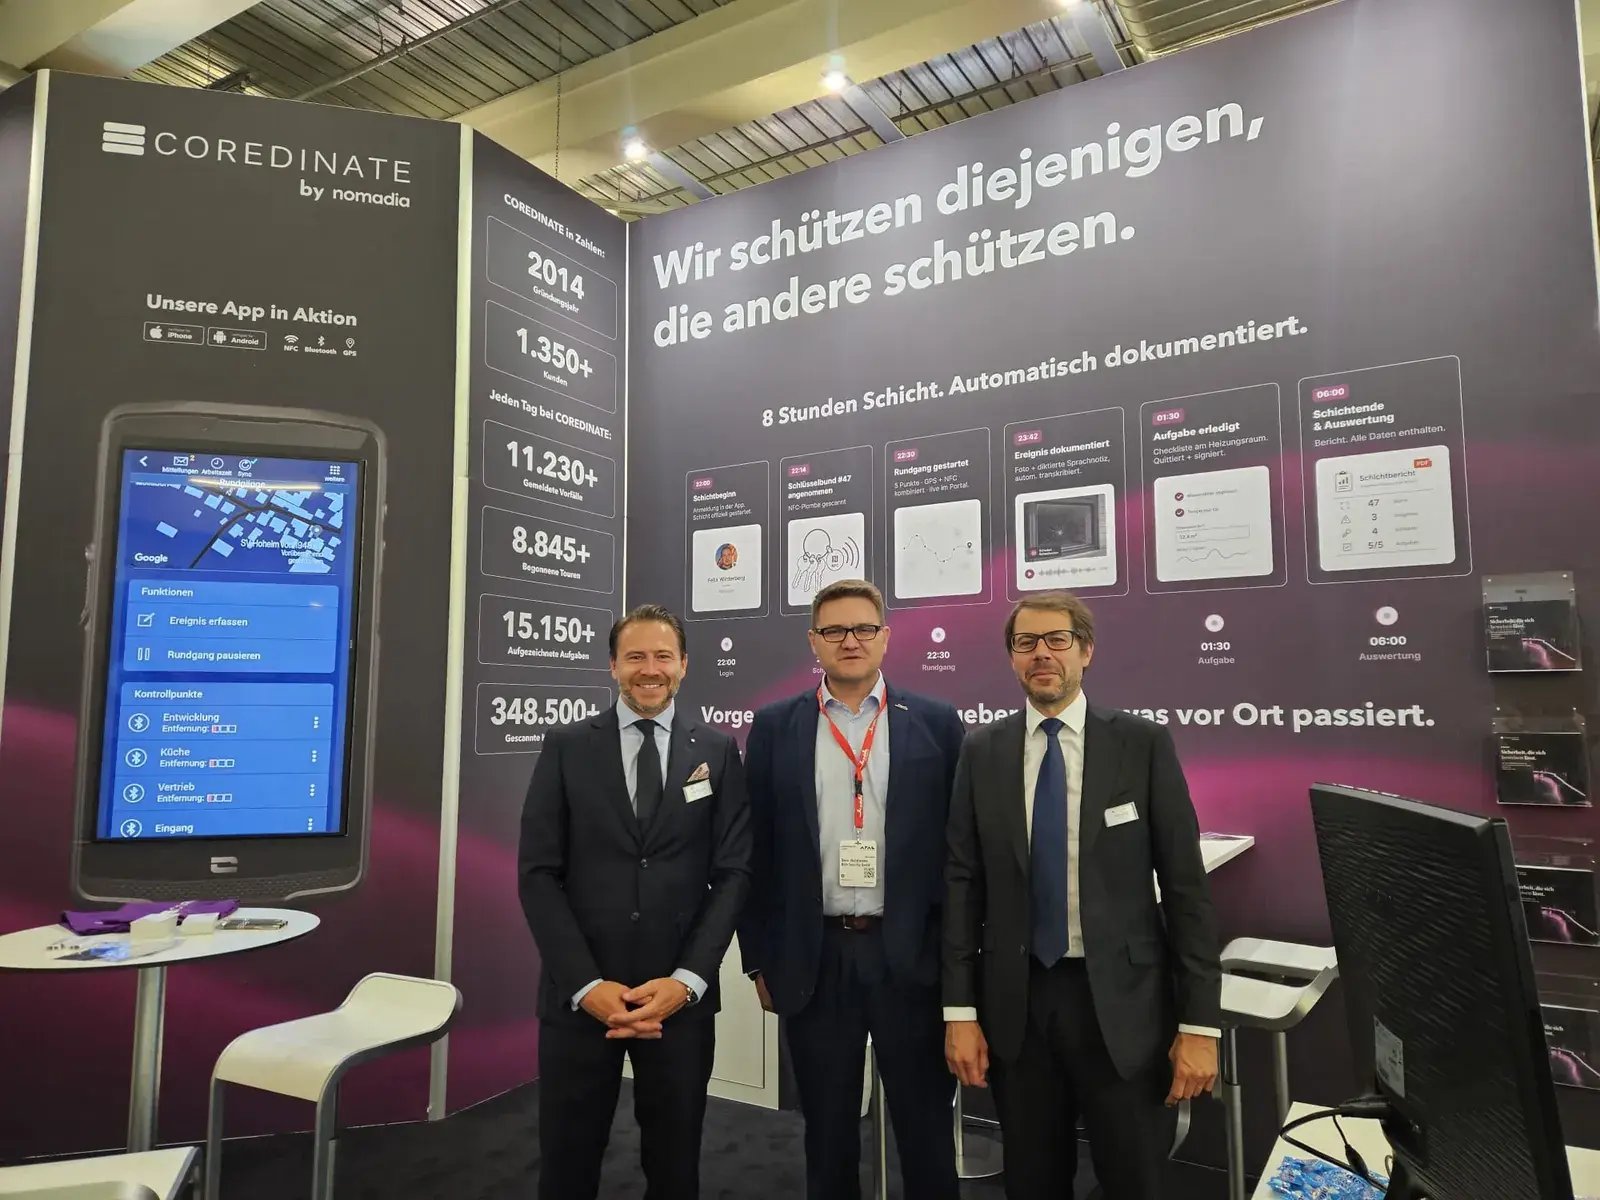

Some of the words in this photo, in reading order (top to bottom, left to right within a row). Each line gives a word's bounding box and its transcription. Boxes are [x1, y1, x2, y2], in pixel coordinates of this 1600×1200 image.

[154, 131, 411, 183] COREDINATE
[300, 179, 324, 201] by
[332, 186, 411, 208] nomadia
[652, 241, 722, 289] Wir
[729, 190, 923, 273] schützen
[936, 101, 1265, 216] diejenigen,
[504, 194, 565, 235] COREDINATE
[566, 228, 574, 240] in
[575, 233, 606, 258] Zahlen:
[528, 251, 585, 300] 2014
[653, 305, 713, 348] die
[722, 272, 873, 333] andere
[882, 210, 1137, 297] schützen.
[533, 286, 580, 313] Gründungsjahr
[147, 294, 218, 314] Unsere
[222, 300, 265, 322] App
[270, 304, 288, 320] in
[293, 307, 358, 327] Aktion
[167, 332, 193, 340] iPhone
[231, 337, 259, 345] Android
[304, 346, 337, 355] Bluetooth
[343, 349, 357, 357] GPS
[516, 327, 593, 378] 1.350+
[762, 409, 774, 428] 8
[778, 396, 858, 425] Stunden
[862, 380, 945, 411] Schicht.
[949, 350, 1098, 397] Automatisch
[1104, 315, 1309, 367] dokumentiert.
[543, 370, 568, 386] Kunden
[1316, 388, 1345, 399] 06:00
[489, 389, 519, 408] Jeden
[521, 399, 537, 416] Tag
[539, 405, 554, 420] bei
[555, 412, 612, 440] COREDINATE:
[1312, 402, 1385, 419] Schichtende
[1156, 412, 1180, 422] 01:30
[1313, 422, 1323, 431] &
[1324, 413, 1395, 431] Auswertung
[1018, 433, 1039, 442] 23:42
[1153, 428, 1196, 442] Aufgabe
[1198, 421, 1240, 436] erledigt
[1314, 436, 1349, 447] Bericht.
[1350, 433, 1368, 443] Alle
[1369, 431, 1396, 441] Daten
[1398, 424, 1446, 438] enthalten.
[1014, 447, 1049, 460] Ereignis
[1050, 439, 1110, 455] dokumentiert
[1153, 443, 1193, 456] Checkliste
[1194, 442, 1207, 450] am
[1208, 434, 1269, 449] Heizungsraum.
[897, 451, 916, 459] 22:30
[1153, 454, 1185, 465] Quittiert
[1194, 449, 1226, 461] signiert.
[506, 440, 598, 488] 11.230+
[894, 465, 932, 476] Rundgang
[932, 459, 969, 472] gestartet
[1037, 461, 1065, 471] diktierte
[1067, 455, 1110, 469] Sprachnotiz,
[162, 466, 199, 475] Mitteilungen
[201, 468, 232, 476] Arbeitszeit
[791, 466, 807, 474] 22:14
[1014, 474, 1037, 482] autom.
[1039, 467, 1082, 479] transkribiert.
[1359, 470, 1416, 482] Schichtbericht
[696, 480, 711, 488] 22:00
[788, 476, 837, 490] Schlüsselbund
[838, 474, 852, 484] #47
[900, 480, 920, 488] Punkte
[924, 477, 937, 485] GPS
[944, 474, 957, 482] NFC
[523, 478, 559, 496] Gemeldete
[559, 488, 583, 501] Vorfälle
[788, 488, 833, 500] angenommen
[894, 487, 925, 496] kombiniert
[693, 490, 737, 502] Schichtbeginn
[693, 504, 719, 514] Anmeldung
[1368, 499, 1380, 507] 47
[693, 513, 711, 521] Schicht
[1371, 513, 1378, 521] 3
[512, 526, 590, 564] 8.845+
[1368, 541, 1384, 550] 5/5
[134, 553, 168, 565] Google
[522, 562, 559, 577] Begonnene
[560, 568, 581, 580] Touren
[141, 587, 194, 598] Funktionen
[169, 616, 207, 627] Ereignis
[208, 617, 248, 627] erfassen
[502, 610, 596, 644] 15.150+
[1200, 641, 1231, 651] 01:30
[1369, 636, 1407, 646] 06:00
[168, 650, 215, 661] Rundgang
[216, 651, 261, 661] pausieren
[507, 646, 559, 659] Aufgezeichnete
[560, 650, 589, 661] Aufgaben
[926, 651, 950, 660] 22:30
[1359, 650, 1422, 662] Auswertung
[717, 658, 736, 667] 22:00
[1198, 655, 1235, 665] Aufgabe
[922, 664, 956, 672] Rundgang
[134, 689, 203, 701] Kontrollpunkte
[490, 697, 600, 725] 348.500+
[1175, 706, 1225, 726] vor
[1232, 702, 1284, 727] Ort
[1293, 701, 1435, 733] passiert.
[163, 713, 220, 724] Entwicklung
[162, 724, 210, 734] Entfernung:
[505, 734, 541, 743] Gescannte
[160, 748, 190, 757] Küche
[160, 759, 208, 769] Entfernung:
[158, 782, 195, 792] Vertrieb
[157, 794, 205, 804] Entfernung:
[155, 824, 193, 834] Eingang
